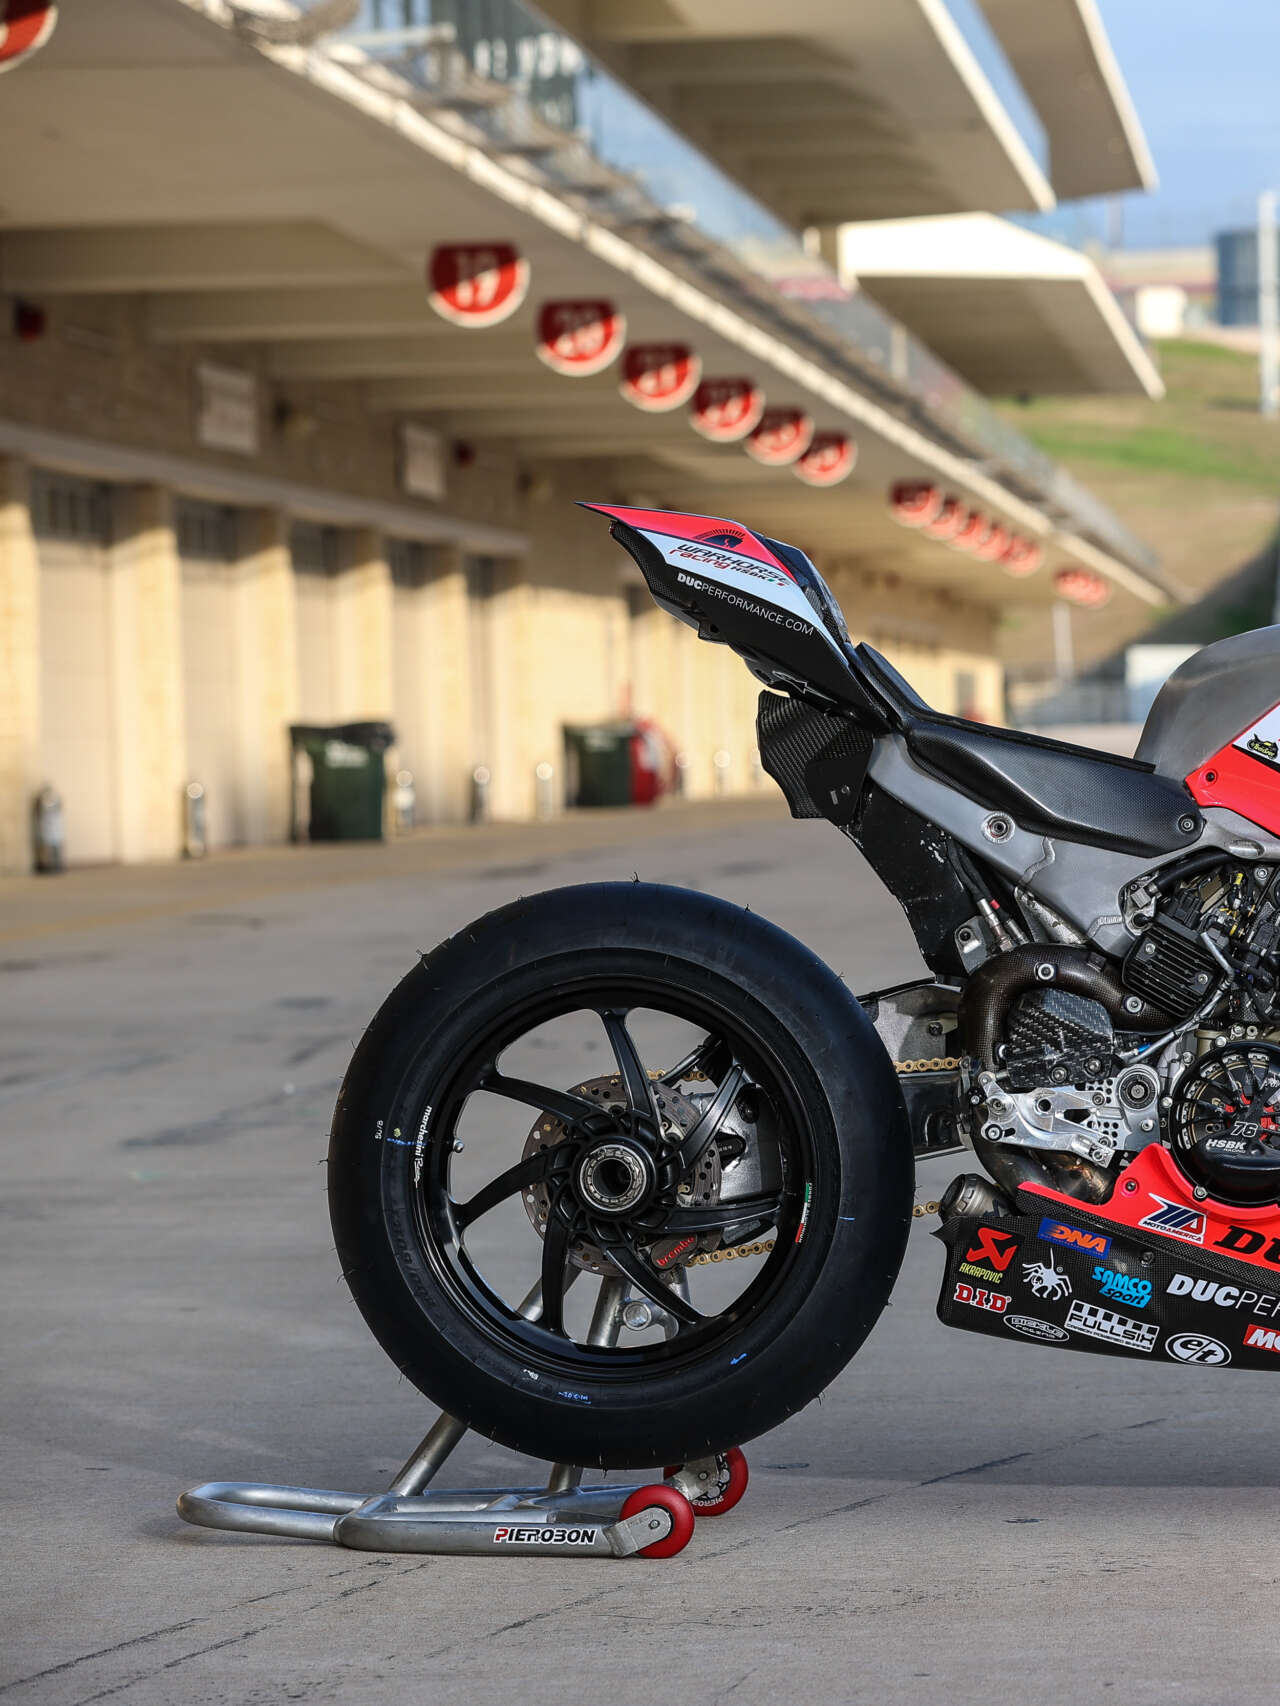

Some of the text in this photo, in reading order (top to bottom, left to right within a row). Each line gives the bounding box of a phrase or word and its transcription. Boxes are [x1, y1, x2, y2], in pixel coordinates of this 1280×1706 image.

[669, 549, 731, 569] racing
[677, 543, 791, 585] WARHORSE
[677, 572, 815, 637] DUCPERFORMANCE.COM
[1230, 1120, 1259, 1138] 76
[1205, 1138, 1247, 1151] HSBK
[1051, 1224, 1107, 1253] DNA
[1142, 1220, 1203, 1242] MOTOAMERICA
[1091, 1266, 1153, 1296] SAMCO
[1102, 1287, 1149, 1306] sport
[1069, 1313, 1155, 1346] FULLSIX
[494, 1527, 598, 1545] PIEROBON
